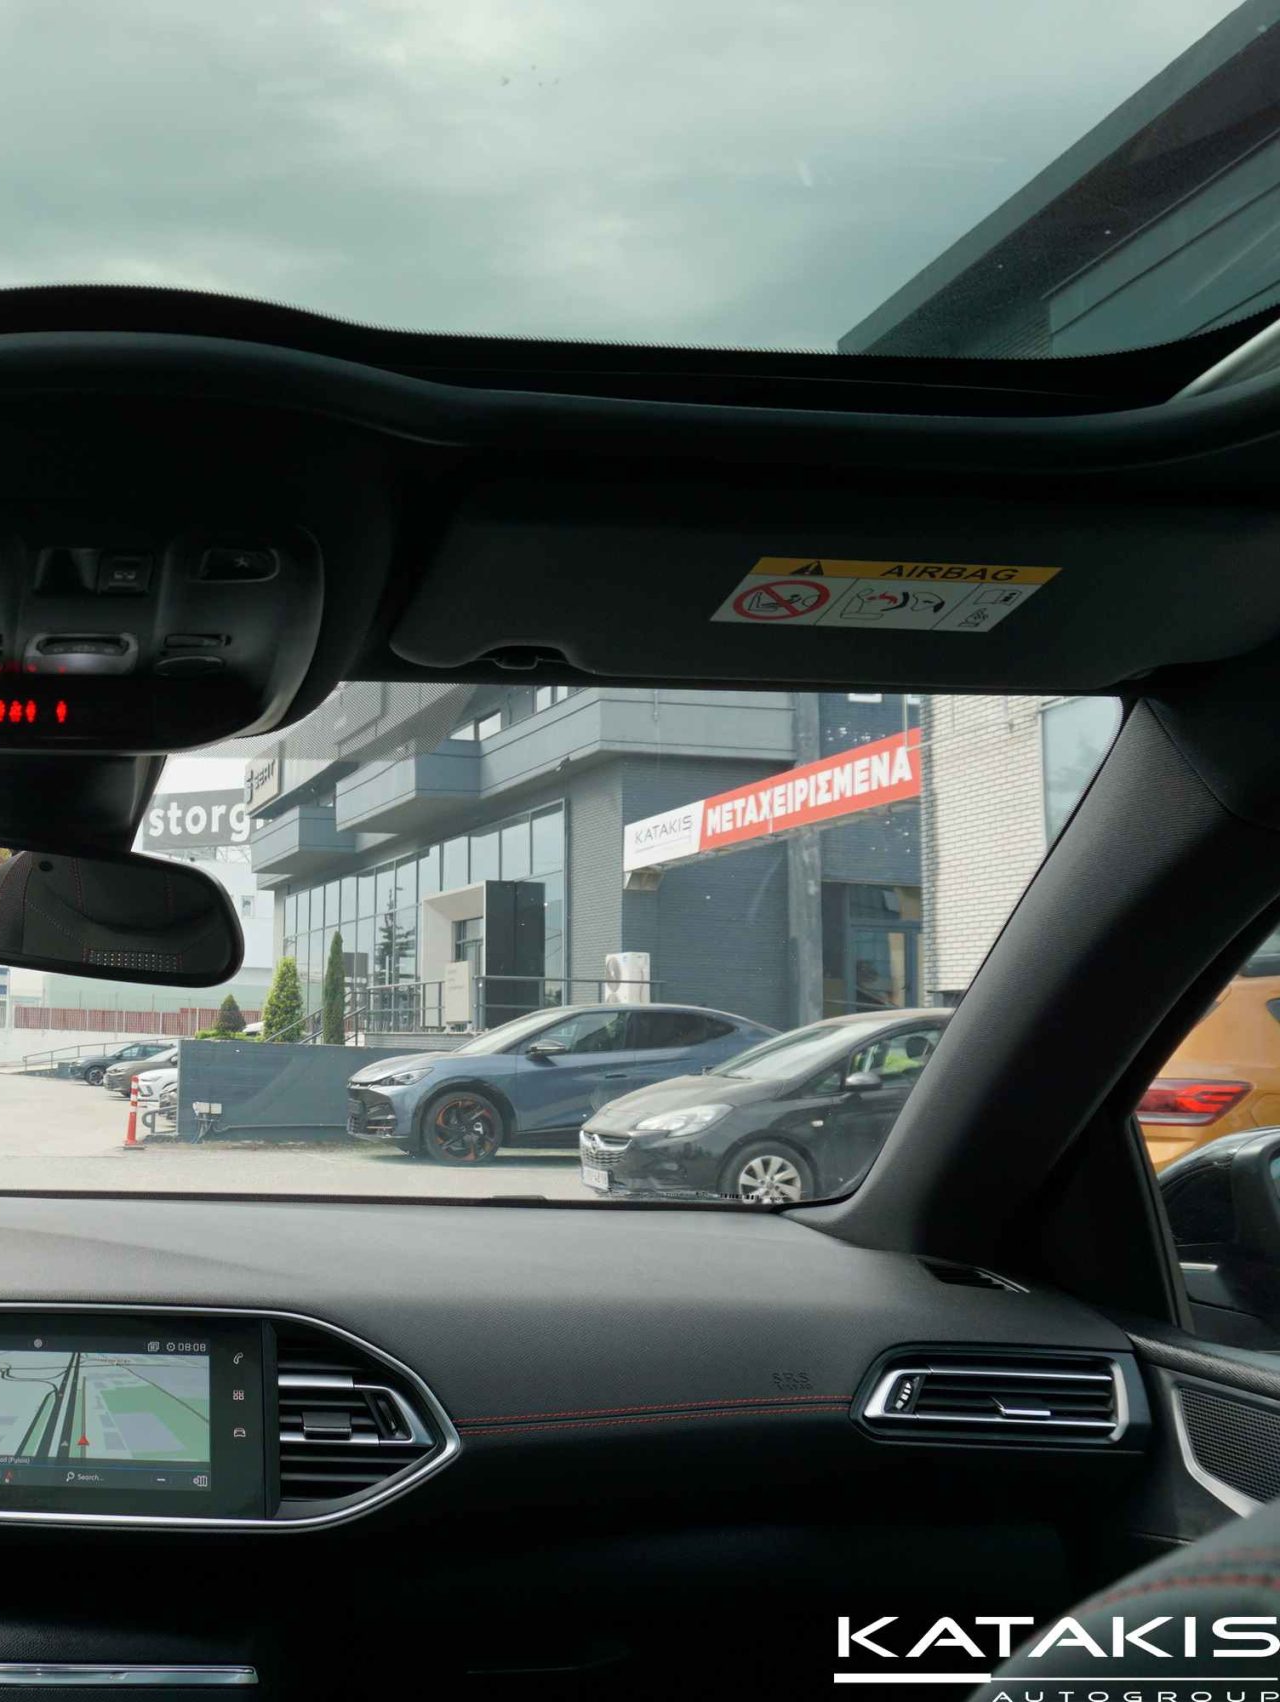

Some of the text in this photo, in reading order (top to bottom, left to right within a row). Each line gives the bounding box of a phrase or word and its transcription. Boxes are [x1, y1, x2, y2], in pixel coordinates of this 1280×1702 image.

[880, 564, 1020, 582] AIRBAG
[706, 745, 913, 838] ΜΕΤΑΧΕΙΡΙΣΜΕΝΑ
[634, 814, 693, 844] KATAKIS
[177, 1342, 207, 1352] 08:08
